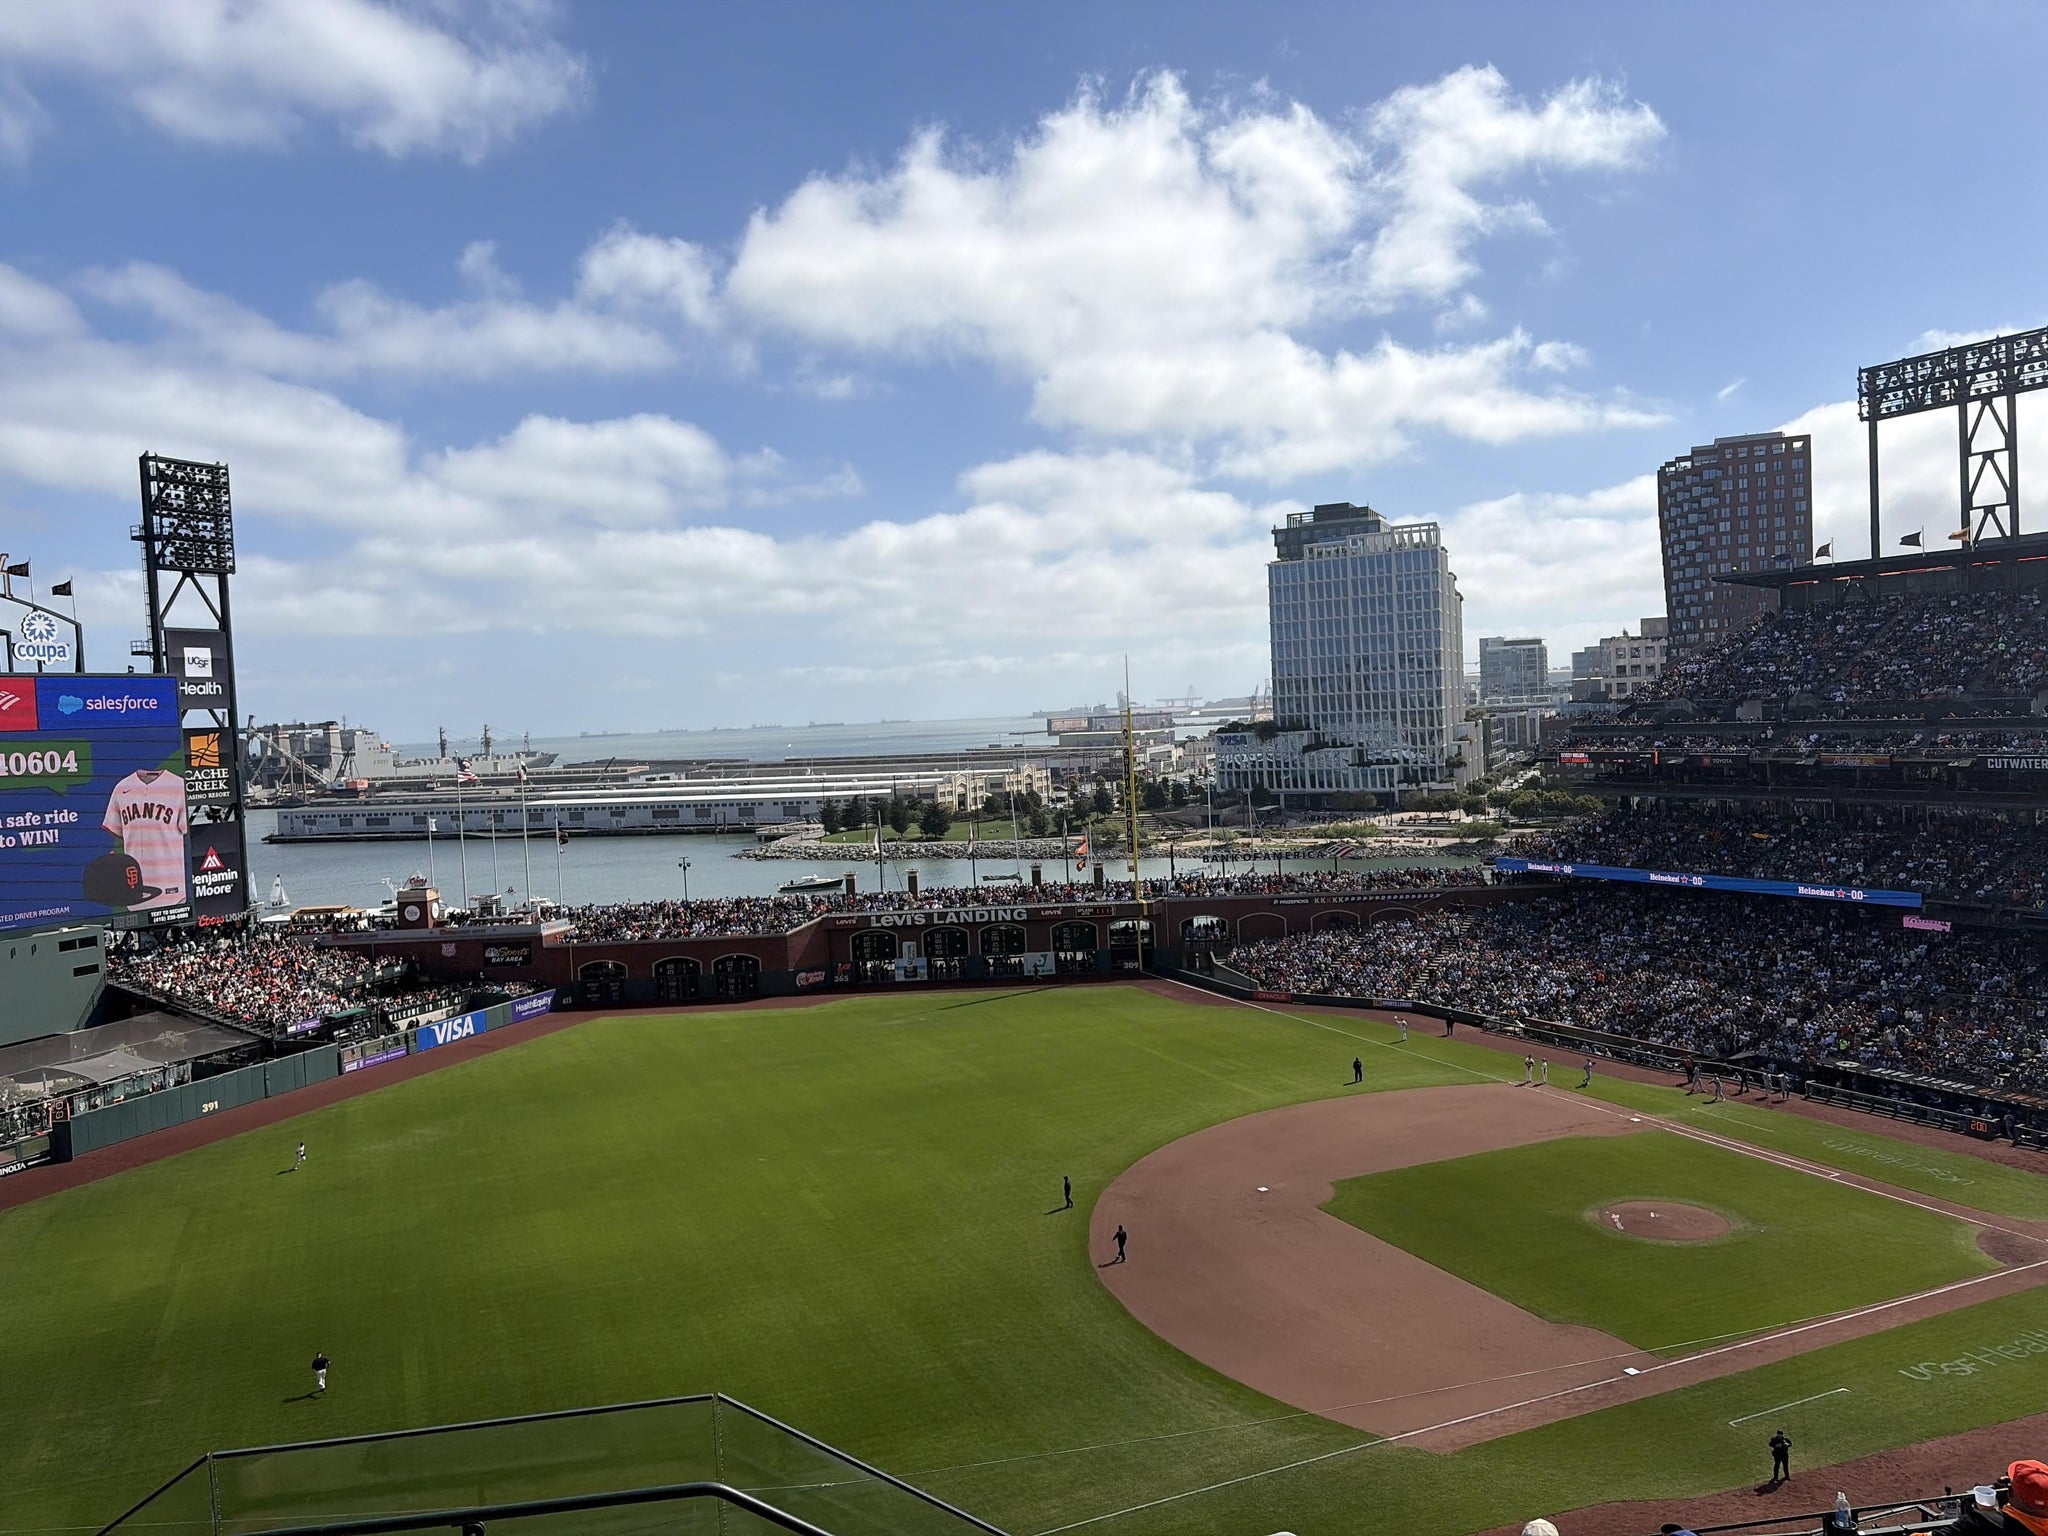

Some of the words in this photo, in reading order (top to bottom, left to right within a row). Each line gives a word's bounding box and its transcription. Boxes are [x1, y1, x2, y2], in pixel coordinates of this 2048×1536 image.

[17, 642, 67, 663] coupa
[187, 655, 210, 669] UCSF
[179, 681, 222, 696] Health
[86, 695, 158, 713] salesforce
[1216, 735, 1247, 745] VISA
[1987, 758, 2048, 769] CUTWATER
[185, 768, 229, 781] CACHE
[186, 779, 228, 792] CREEK
[6, 812, 41, 828] safe
[44, 809, 79, 825] ride
[121, 802, 174, 826] GIANTS
[0, 834, 16, 848] to
[19, 829, 60, 846] WIN!
[1202, 854, 1239, 863] BANK
[1243, 852, 1261, 861] OF
[1264, 850, 1326, 861] AMERICA
[1527, 862, 1553, 871] Heineken
[1650, 873, 1680, 884] Heineken
[195, 884, 233, 898] Moore
[1798, 886, 1835, 897] Heineken
[15, 910, 38, 921] DRIVER
[39, 905, 70, 917] PROGRAM
[169, 906, 191, 915] SECURITY
[933, 908, 1028, 924] LANDING
[197, 914, 225, 927] Coors
[225, 910, 248, 923] LIGHT
[498, 946, 530, 957] Sports
[1123, 961, 1139, 969] 309
[834, 975, 849, 983] 365
[388, 1007, 420, 1021] WELCOME
[425, 1003, 433, 1012] TO
[437, 1000, 449, 1009] THE
[515, 996, 552, 1013] HealthEquity
[430, 1016, 475, 1045] VISA
[202, 1101, 219, 1113] 391
[0, 1161, 26, 1176] NOLIA
